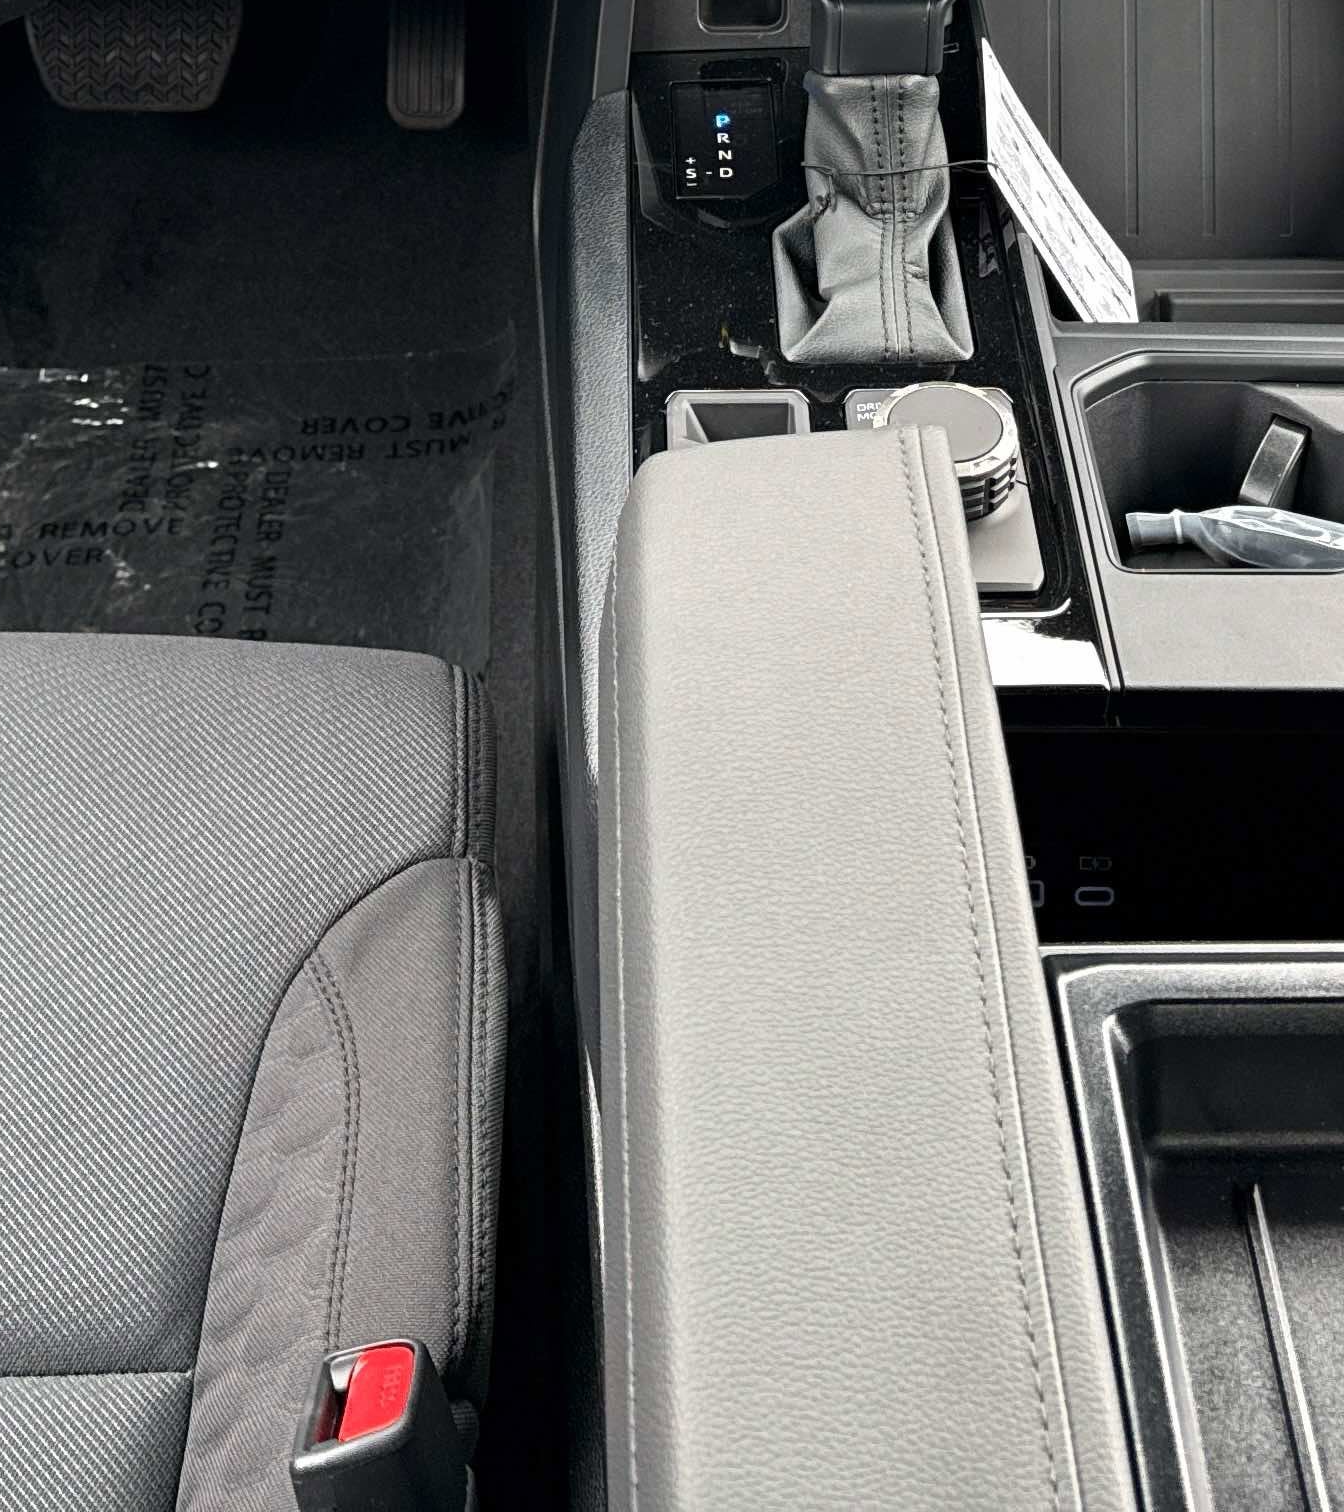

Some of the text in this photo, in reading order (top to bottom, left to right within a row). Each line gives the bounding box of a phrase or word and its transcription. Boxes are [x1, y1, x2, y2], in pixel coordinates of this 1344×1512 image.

[716, 115, 731, 128] P
[717, 133, 731, 143] R
[718, 150, 732, 160] N
[686, 168, 697, 179] S
[719, 168, 733, 178] D
[39, 515, 185, 540] REMOVE
